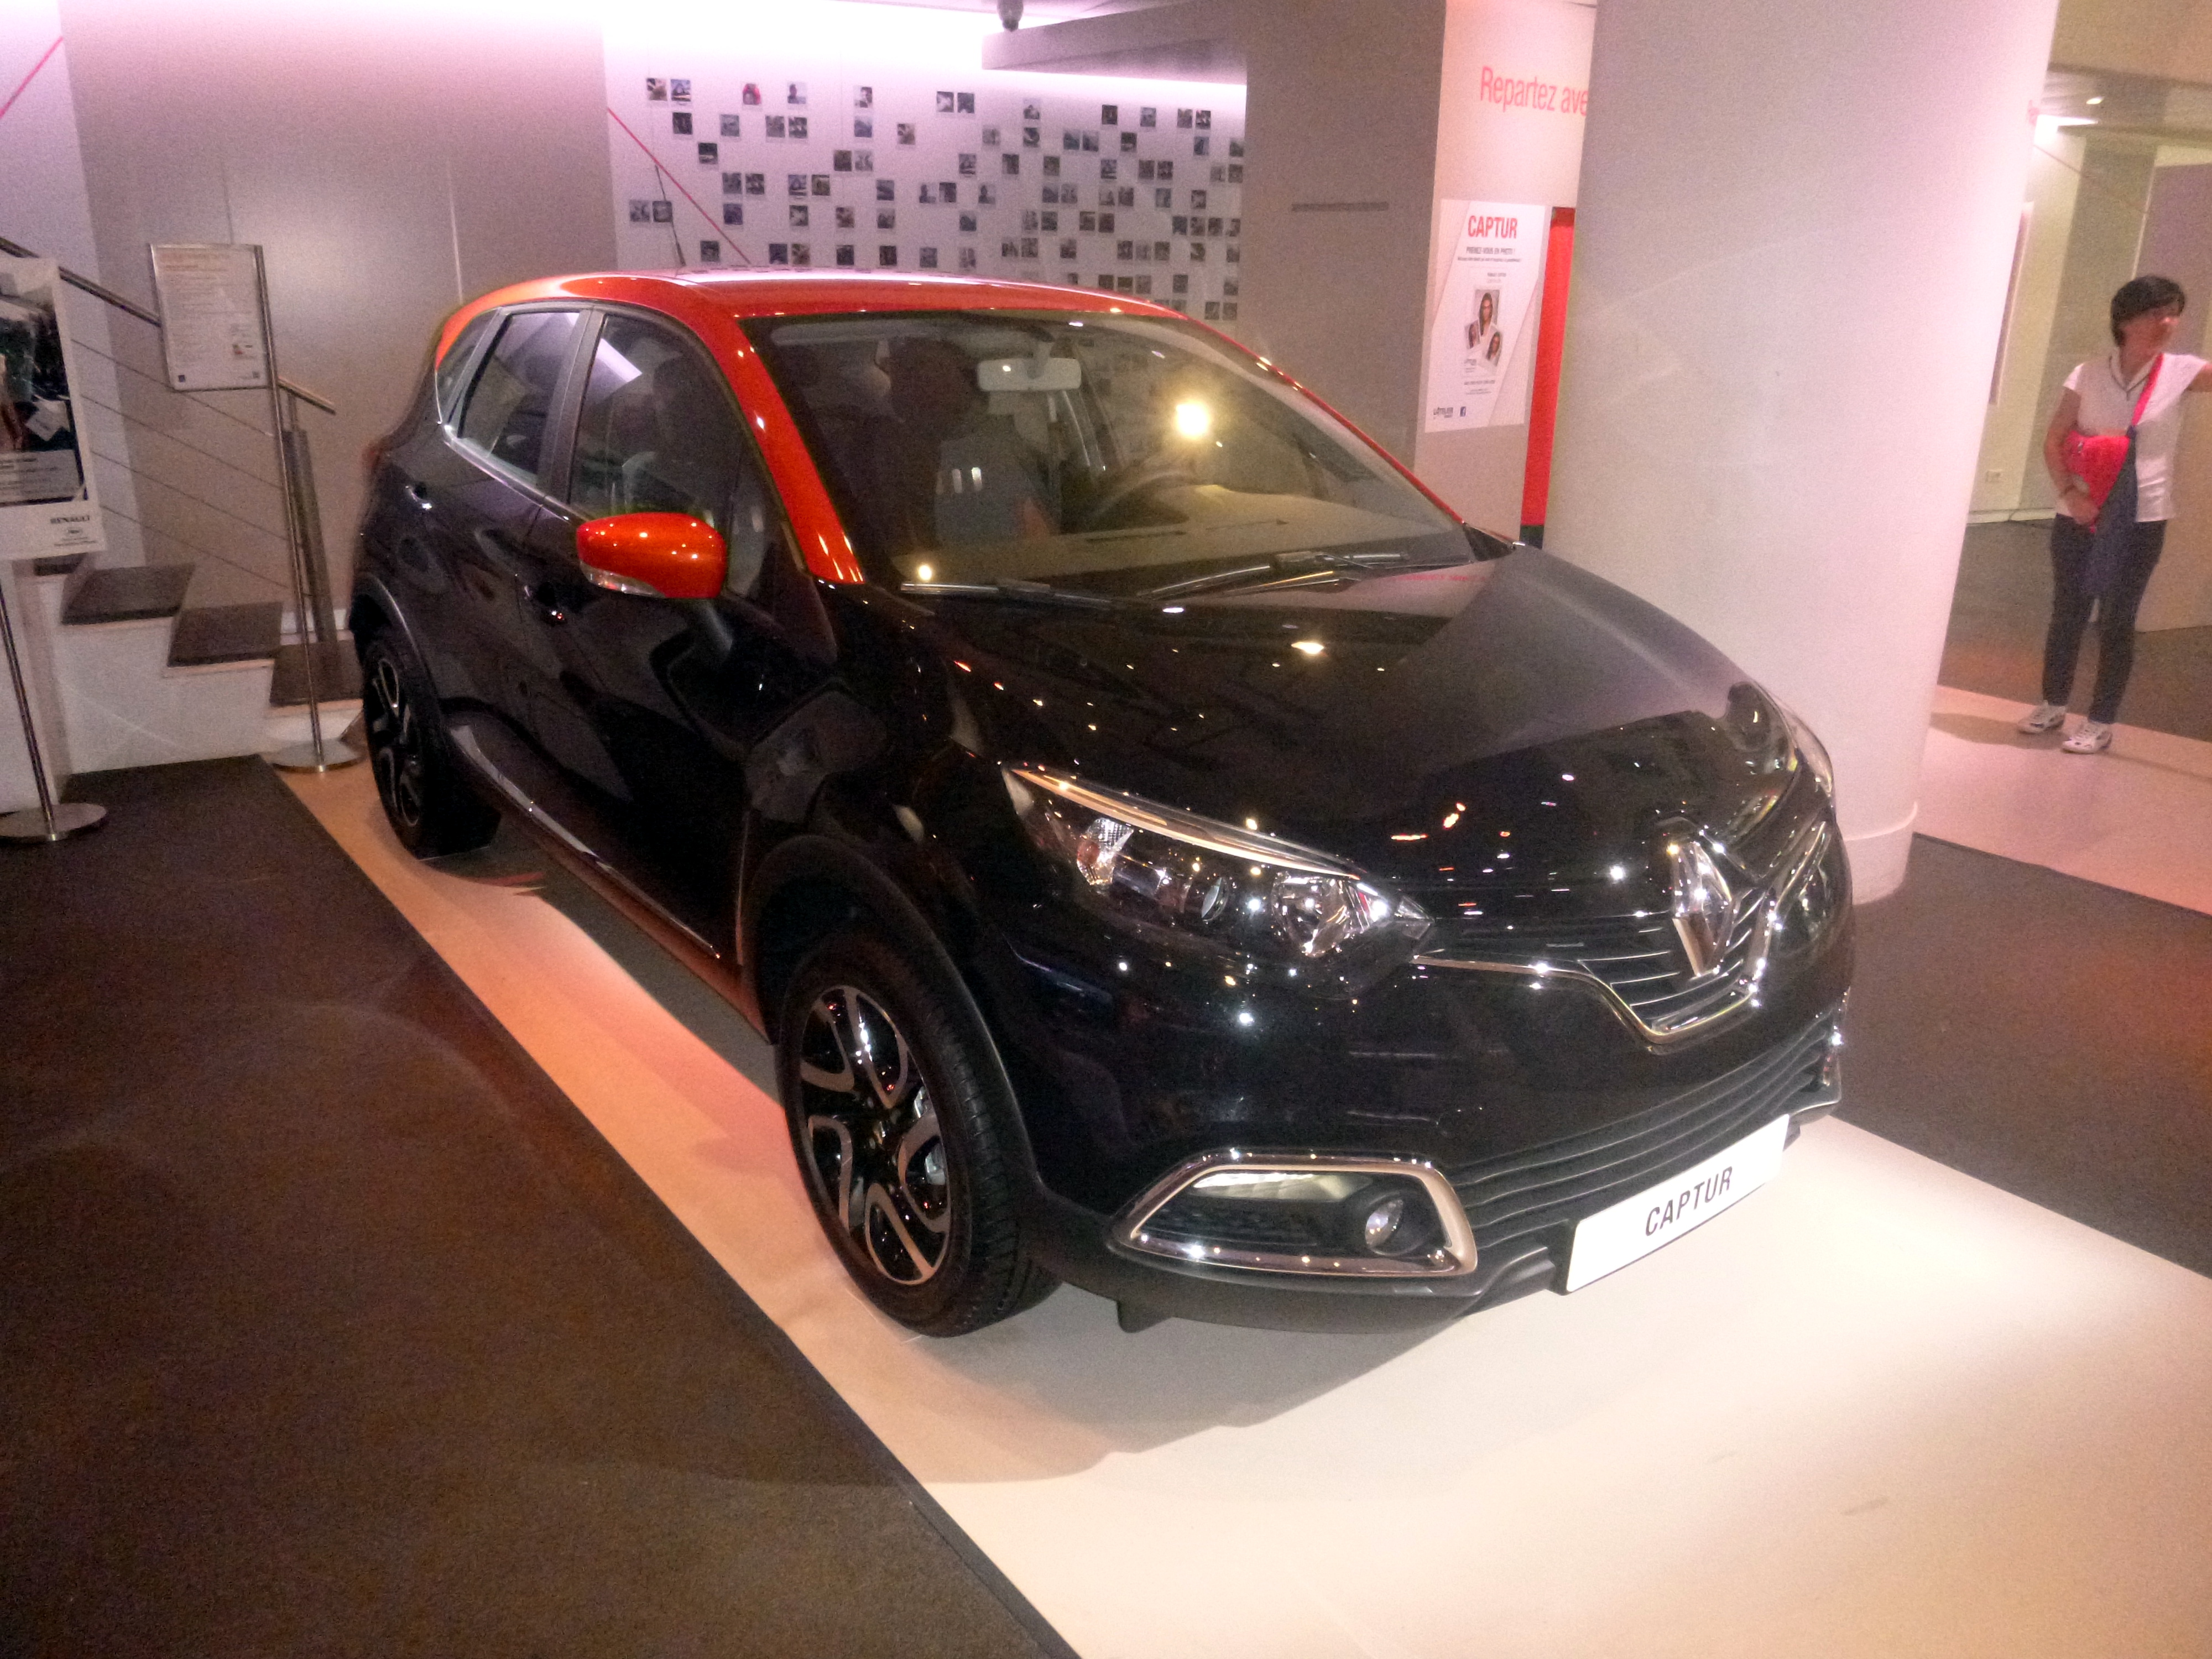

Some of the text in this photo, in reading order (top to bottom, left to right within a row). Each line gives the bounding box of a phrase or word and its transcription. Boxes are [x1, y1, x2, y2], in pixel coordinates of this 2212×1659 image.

[1480, 65, 1557, 112] Repartez
[1468, 215, 1518, 239] CAPTUR
[1645, 1166, 1733, 1237] CAPTUR
